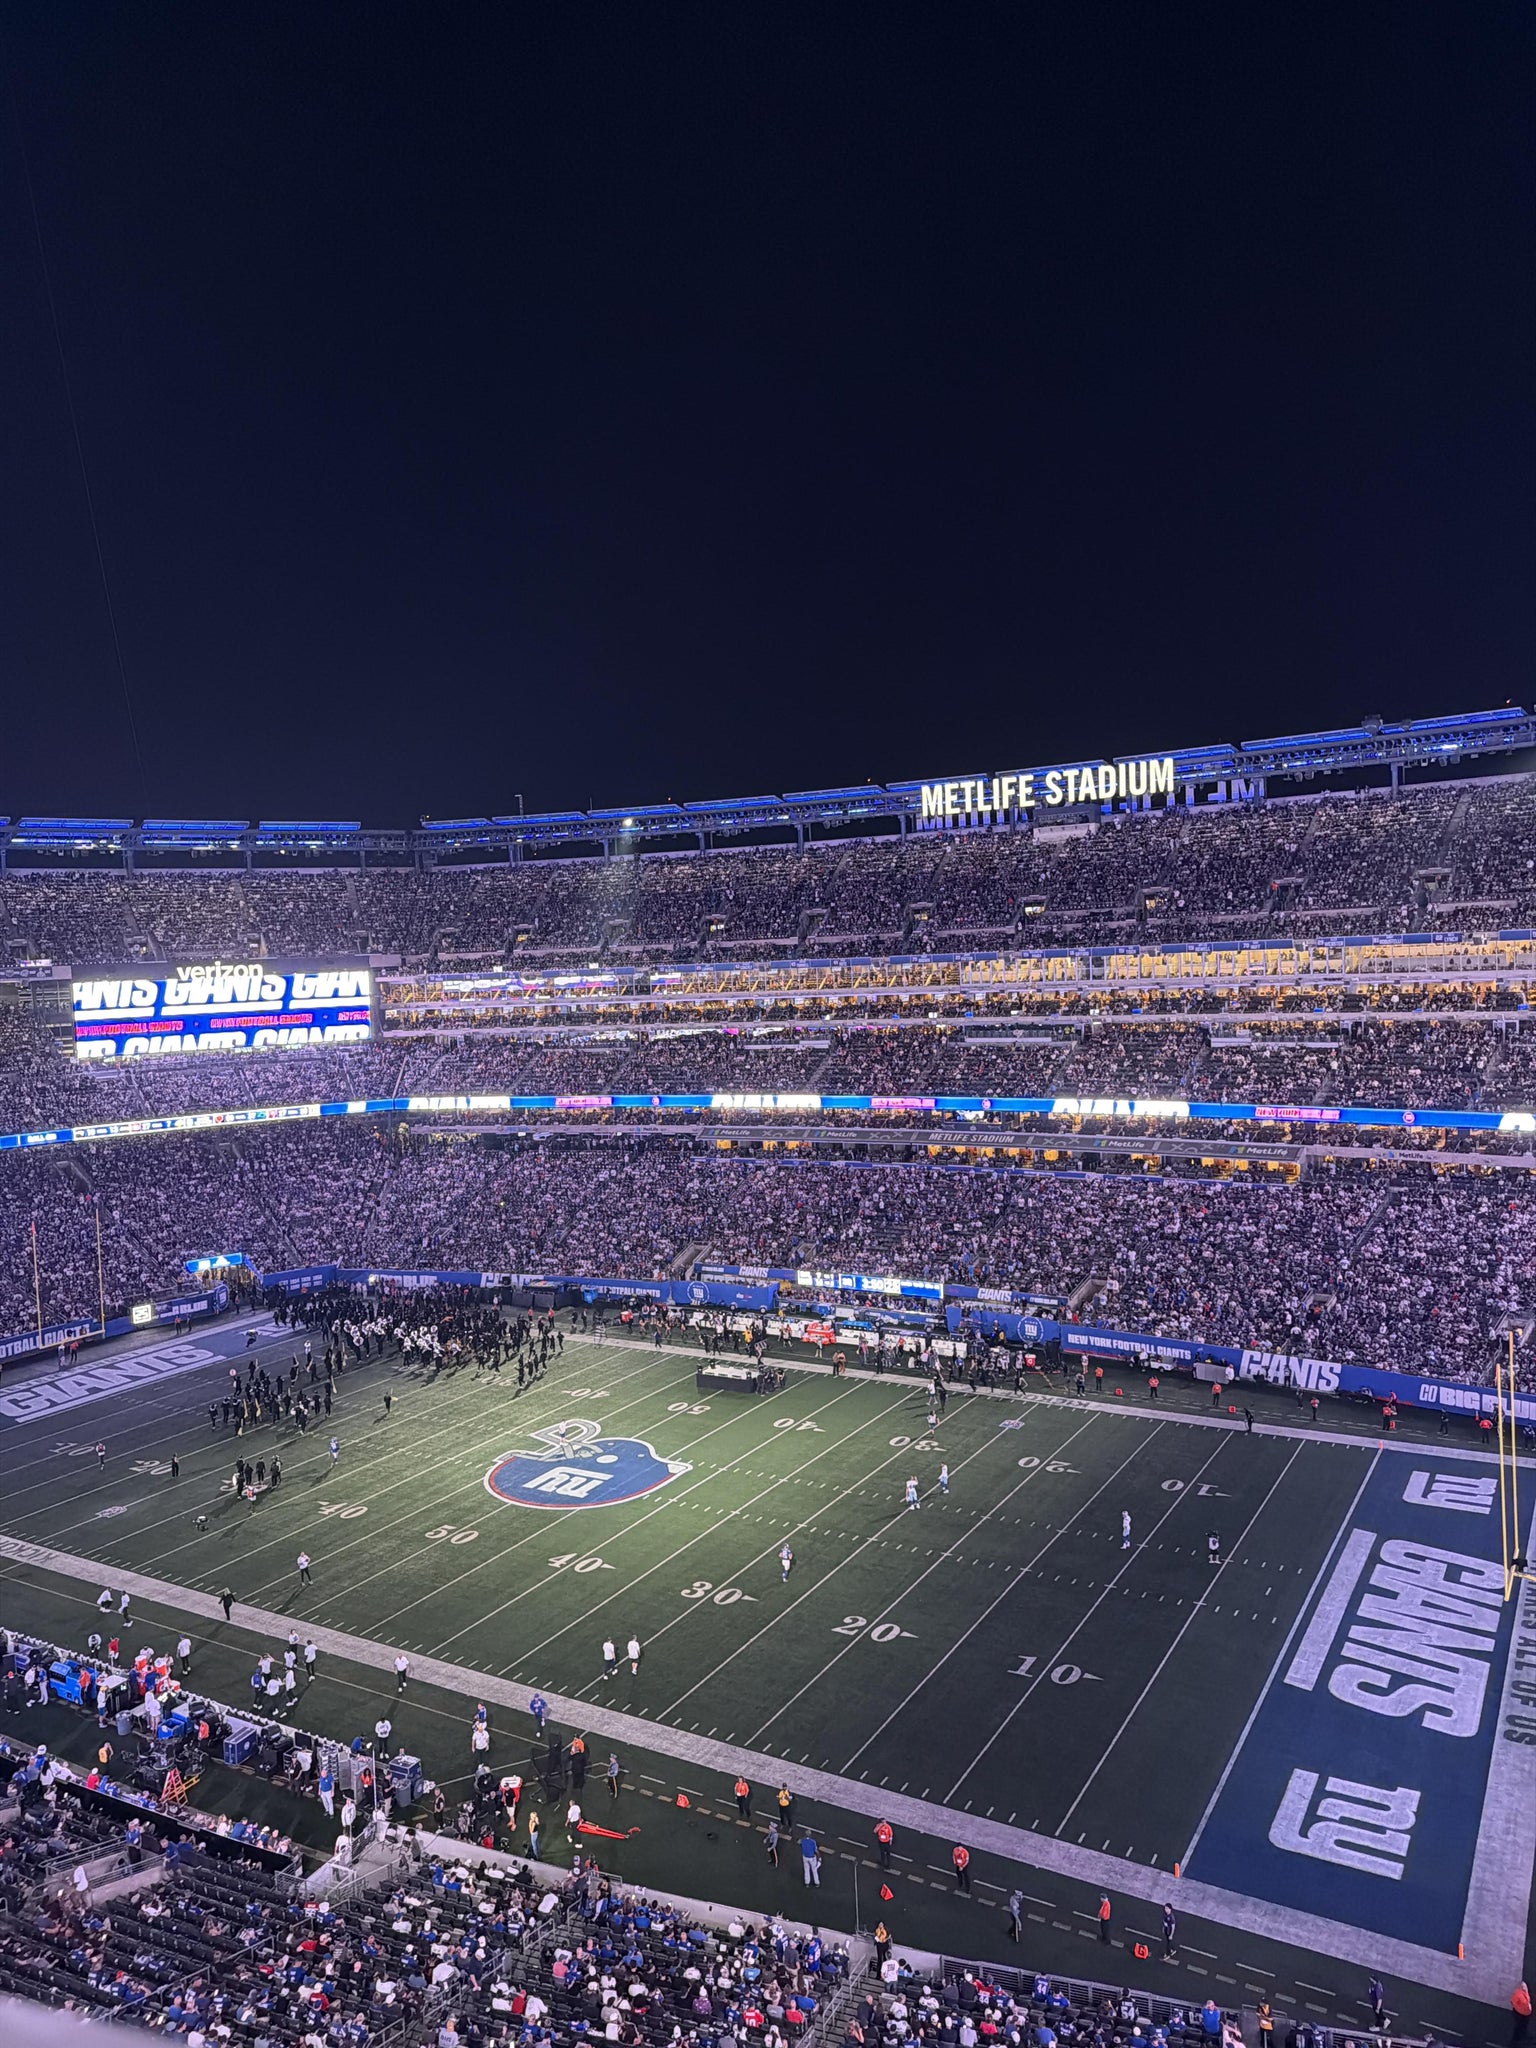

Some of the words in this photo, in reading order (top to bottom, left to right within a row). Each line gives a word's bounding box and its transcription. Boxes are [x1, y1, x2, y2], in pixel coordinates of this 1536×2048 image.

[921, 774, 1035, 817] METLIFE
[1045, 758, 1175, 805] STADIUM
[176, 961, 264, 980] verizon
[720, 1129, 750, 1137] MetLife
[826, 1131, 857, 1139] MetLife
[928, 1132, 969, 1142] METLIFE
[970, 1134, 1015, 1144] STADIUM
[1108, 1140, 1145, 1149] MetLife
[1246, 1146, 1288, 1156] MetLife
[1399, 1152, 1424, 1160] MetLife
[739, 1266, 769, 1278] GIANTS
[977, 1287, 1013, 1301] GIANTS
[1067, 1333, 1089, 1346] NEW
[1089, 1336, 1112, 1349] YORK
[1112, 1339, 1156, 1355] FOOTBALL
[1157, 1345, 1192, 1361] GIANTS
[1239, 1350, 1342, 1392] GIANTS
[0, 1344, 214, 1418] GIANTS
[1419, 1383, 1438, 1403] GO
[1439, 1386, 1481, 1411] BIG
[667, 1402, 711, 1415] 50
[773, 1418, 818, 1432] 40
[49, 1442, 96, 1457] 10
[889, 1436, 940, 1451] 30
[1018, 1456, 1073, 1473] 20
[1161, 1479, 1220, 1496] 10
[318, 1502, 369, 1519] 40
[424, 1524, 480, 1544] 50
[547, 1552, 604, 1573] 40
[680, 1580, 743, 1606] 30
[831, 1615, 901, 1642] 20
[1328, 1538, 1508, 1738] GIANTS
[1007, 1655, 1082, 1685] 10
[1510, 1680, 1536, 1708] OF
[1503, 1714, 1536, 1746] US
[1036, 1983, 1047, 1995] 44
[1120, 2005, 1135, 2020] 54
[745, 2018, 756, 2027] 10
